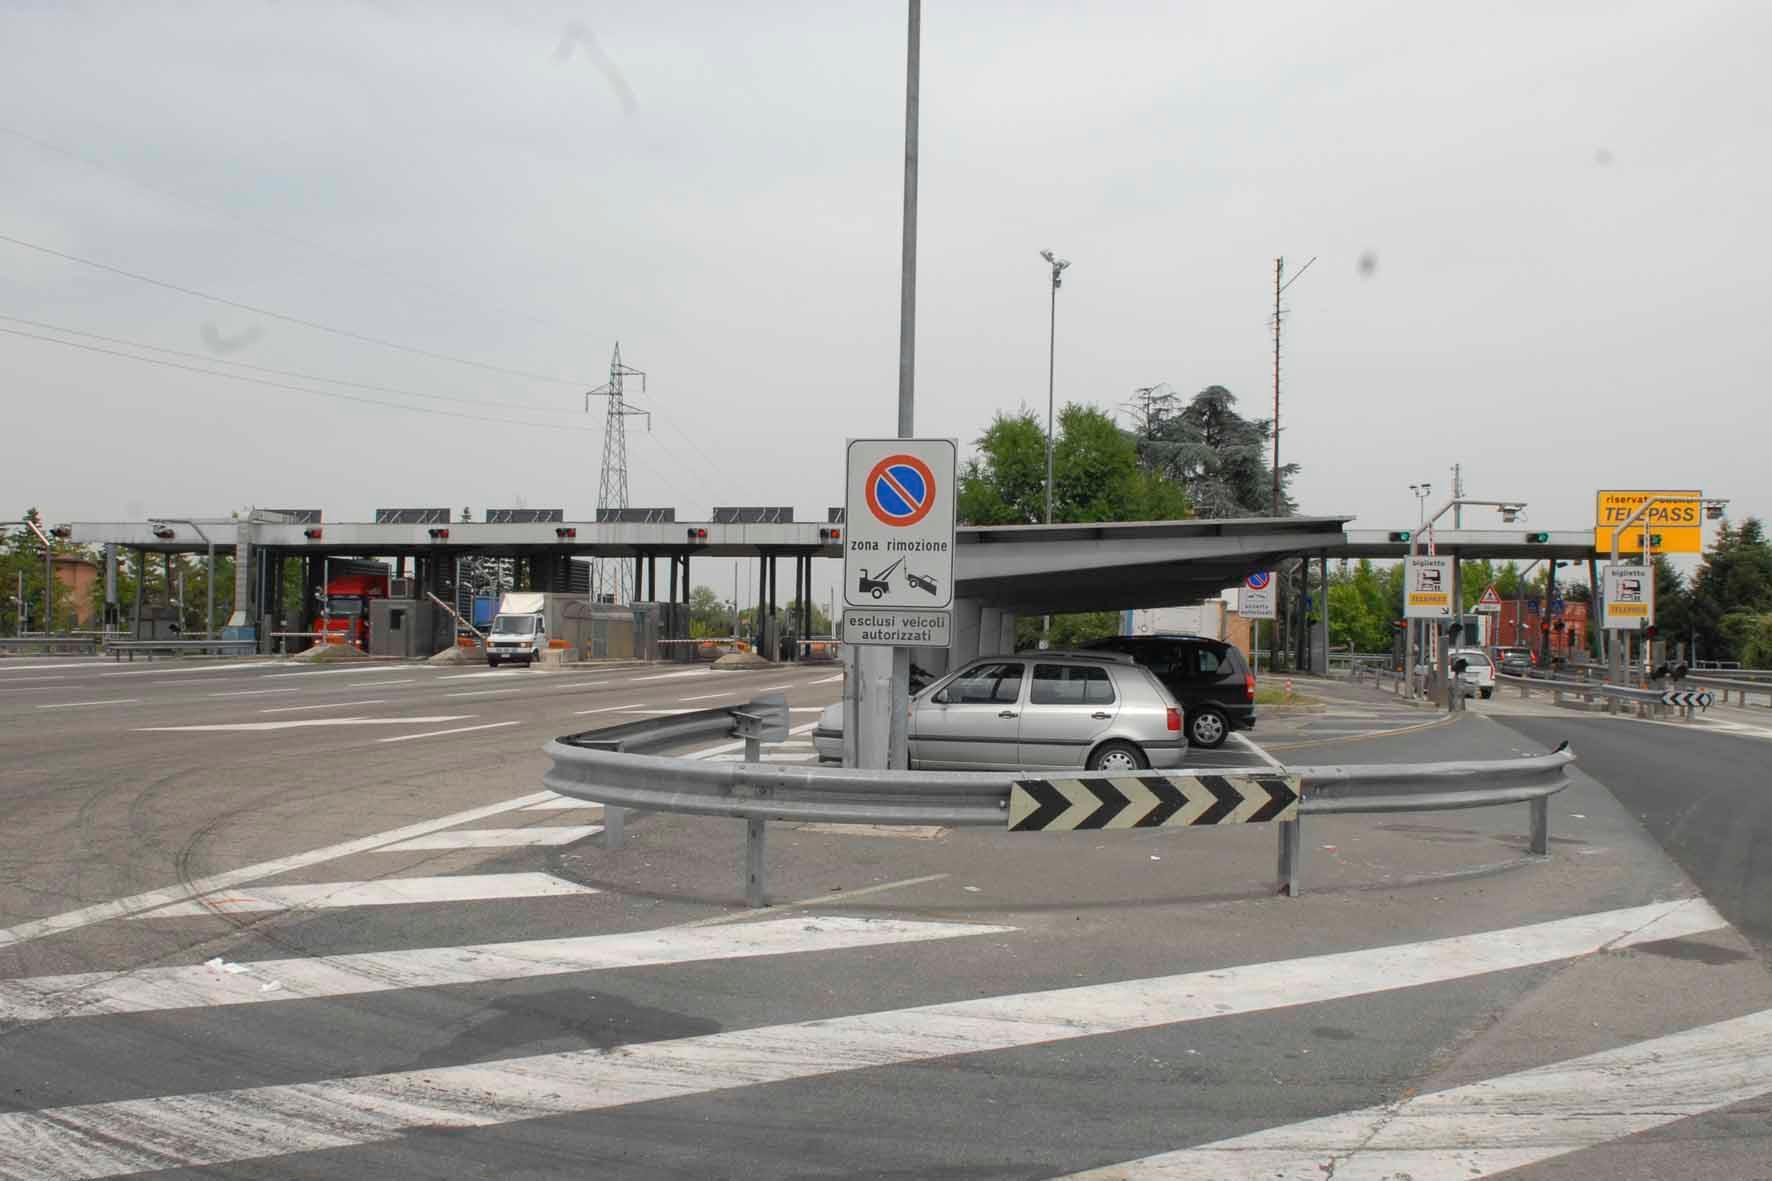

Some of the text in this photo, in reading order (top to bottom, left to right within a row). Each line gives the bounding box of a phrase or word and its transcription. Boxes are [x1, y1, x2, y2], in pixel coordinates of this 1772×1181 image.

[1606, 495, 1650, 504] riservat
[851, 538, 948, 552] zona rimozione
[849, 616, 945, 628] esclusi veicoli
[862, 630, 932, 641] autorizzati
